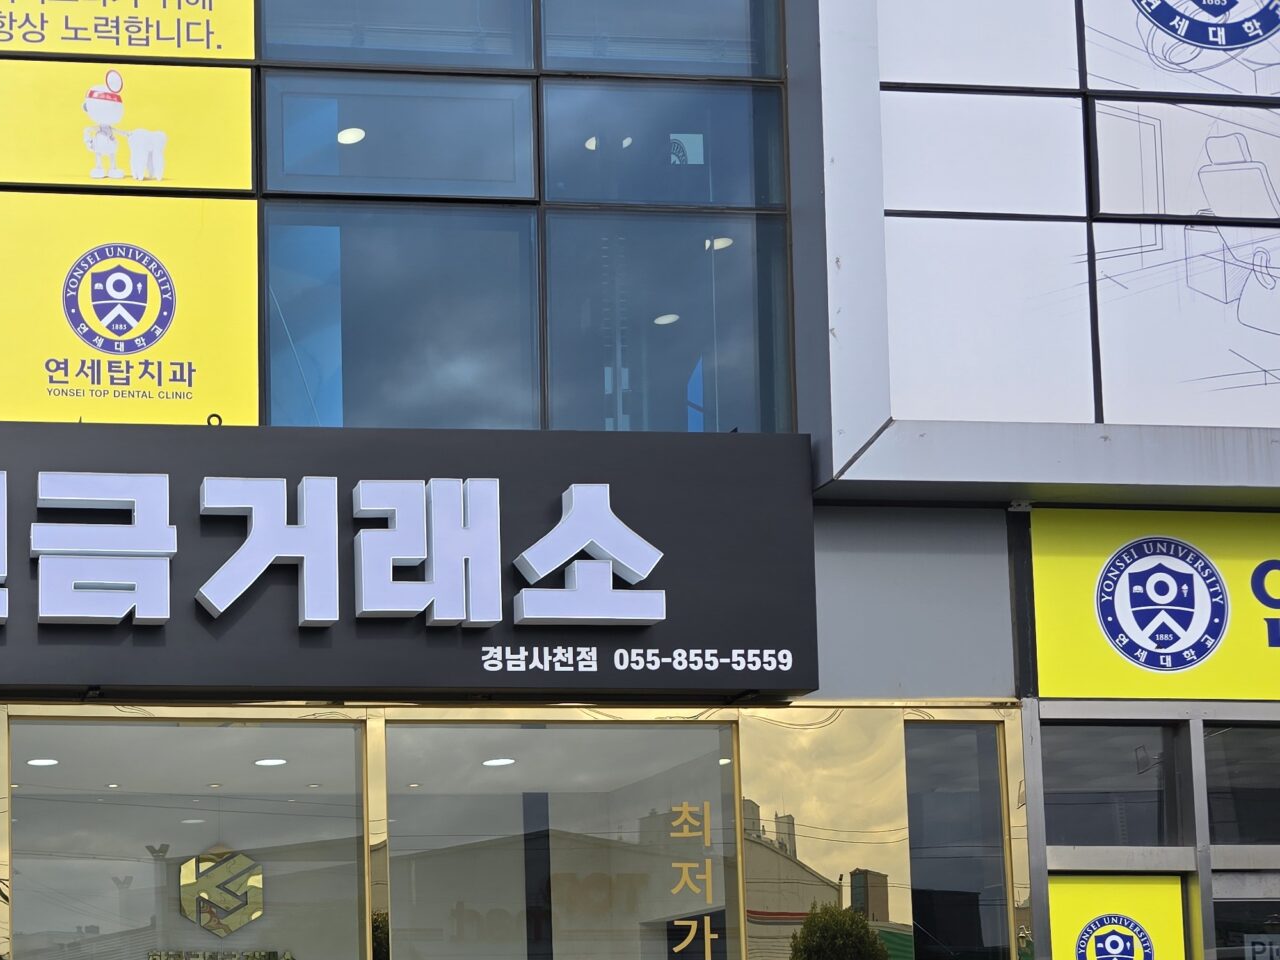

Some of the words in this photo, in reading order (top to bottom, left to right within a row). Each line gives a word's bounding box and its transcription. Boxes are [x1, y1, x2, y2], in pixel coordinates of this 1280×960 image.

[61, 15, 222, 49] 노력합니다.
[67, 252, 101, 297] YONSEI
[105, 247, 172, 300] UNIVERSITY
[45, 357, 197, 387] 연세탑치과
[46, 388, 85, 397] YONSEI
[89, 389, 109, 398] TOP
[113, 390, 154, 399] DENTAL
[158, 391, 193, 400] CLINIC
[1101, 548, 1139, 603] YONSEI
[1143, 542, 1223, 604] UNIVERSITY
[1116, 633, 1215, 667] 연세대학교
[1155, 633, 1173, 641] 1885
[481, 646, 598, 672] 경남사천점
[613, 648, 793, 672] 055-855-5559
[1078, 921, 1100, 953] YONSEI
[1103, 916, 1151, 953] UNIVERSITY
